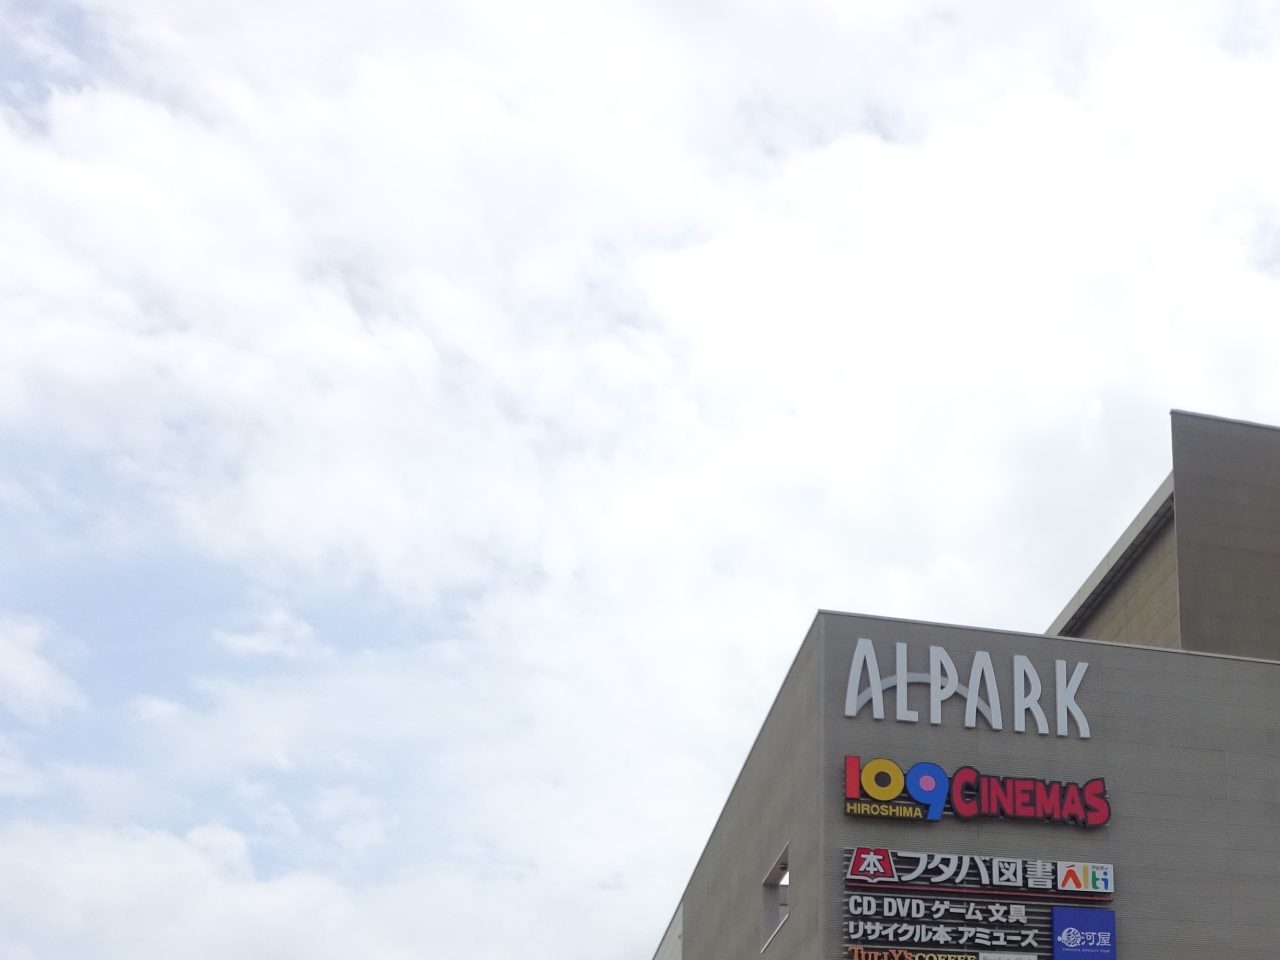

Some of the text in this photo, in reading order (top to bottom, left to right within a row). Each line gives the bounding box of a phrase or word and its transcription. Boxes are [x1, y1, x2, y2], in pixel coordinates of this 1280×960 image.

[844, 638, 1091, 738] ALPARK
[845, 755, 1112, 827] 109 CINEMAS
[846, 802, 923, 819] HIROSHIMA
[858, 851, 1055, 889] 本 フタバ図書
[849, 895, 1028, 924] CD DVD ゲーム 文具
[849, 920, 1040, 948] リサイクル本 アミューズ
